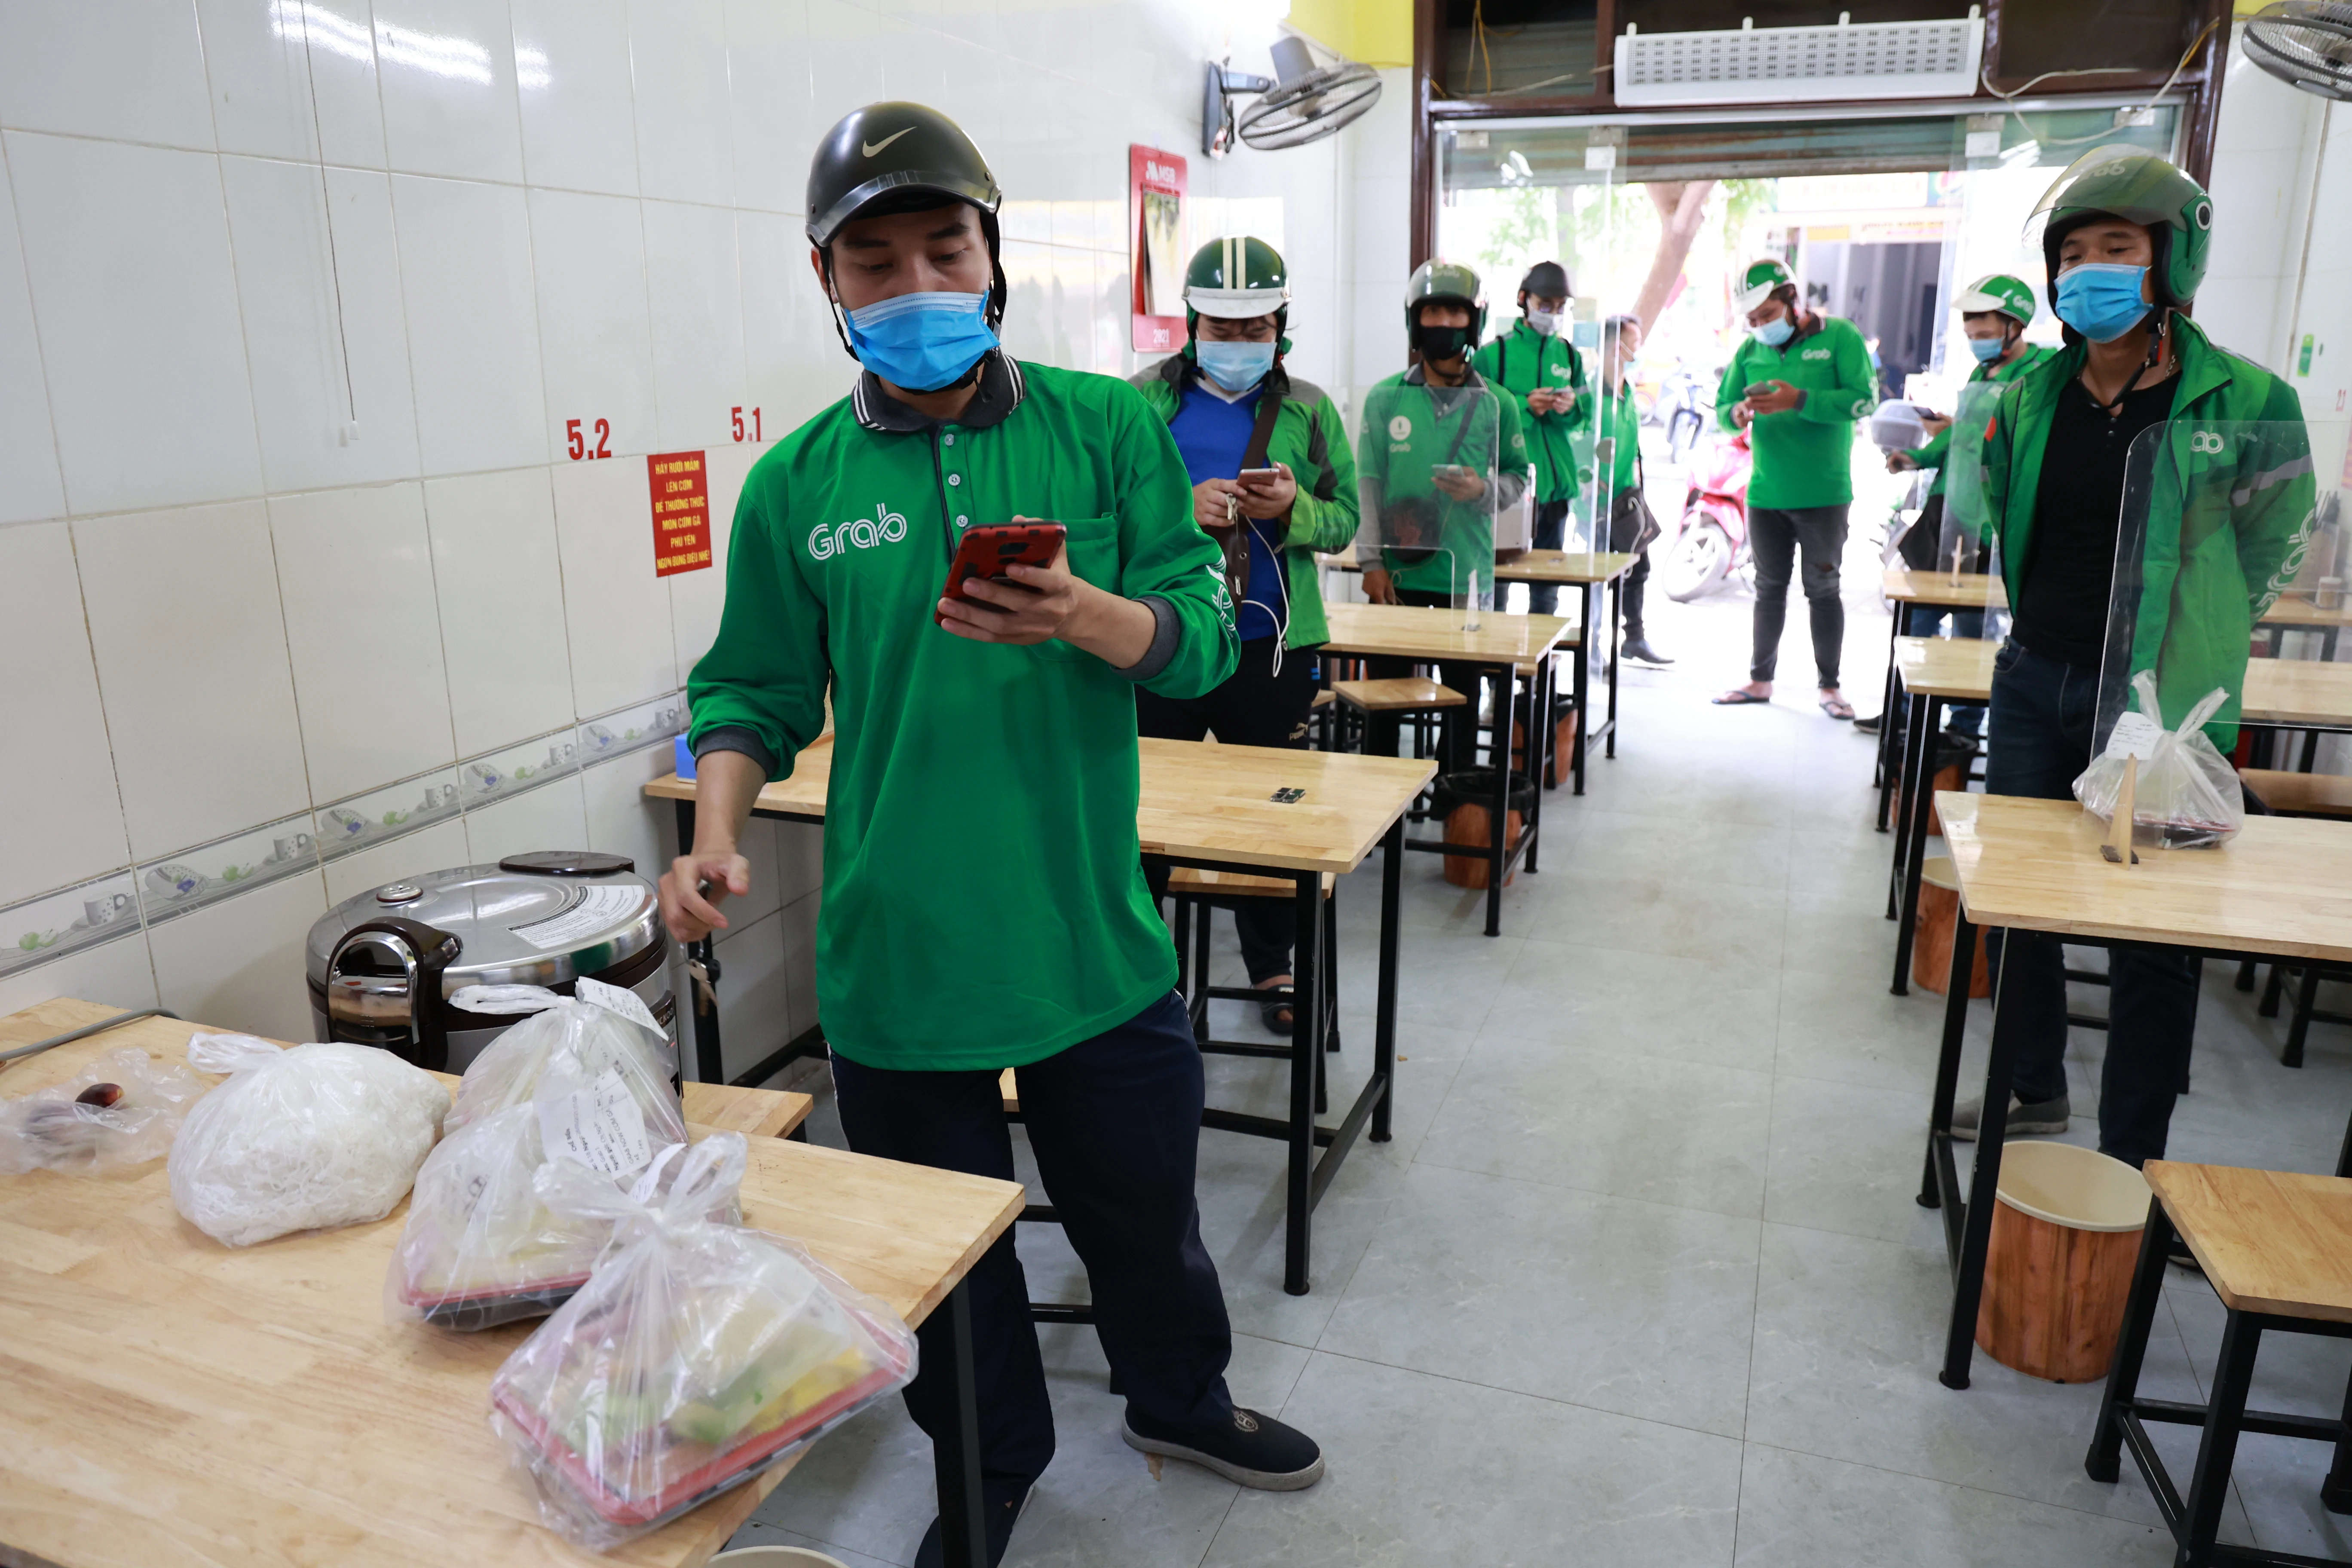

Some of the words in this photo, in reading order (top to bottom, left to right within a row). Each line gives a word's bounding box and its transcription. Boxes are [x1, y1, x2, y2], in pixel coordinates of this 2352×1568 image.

[1153, 328, 1170, 344] 2021
[1801, 348, 1831, 361] Grab
[1551, 363, 1571, 380] Gra
[731, 407, 761, 442] 5.1
[566, 418, 611, 460] 5.2
[2190, 426, 2224, 454] ab
[808, 502, 907, 560] Grab
[617, 1132, 628, 1148] NOW
[625, 1148, 634, 1164] GRAB
